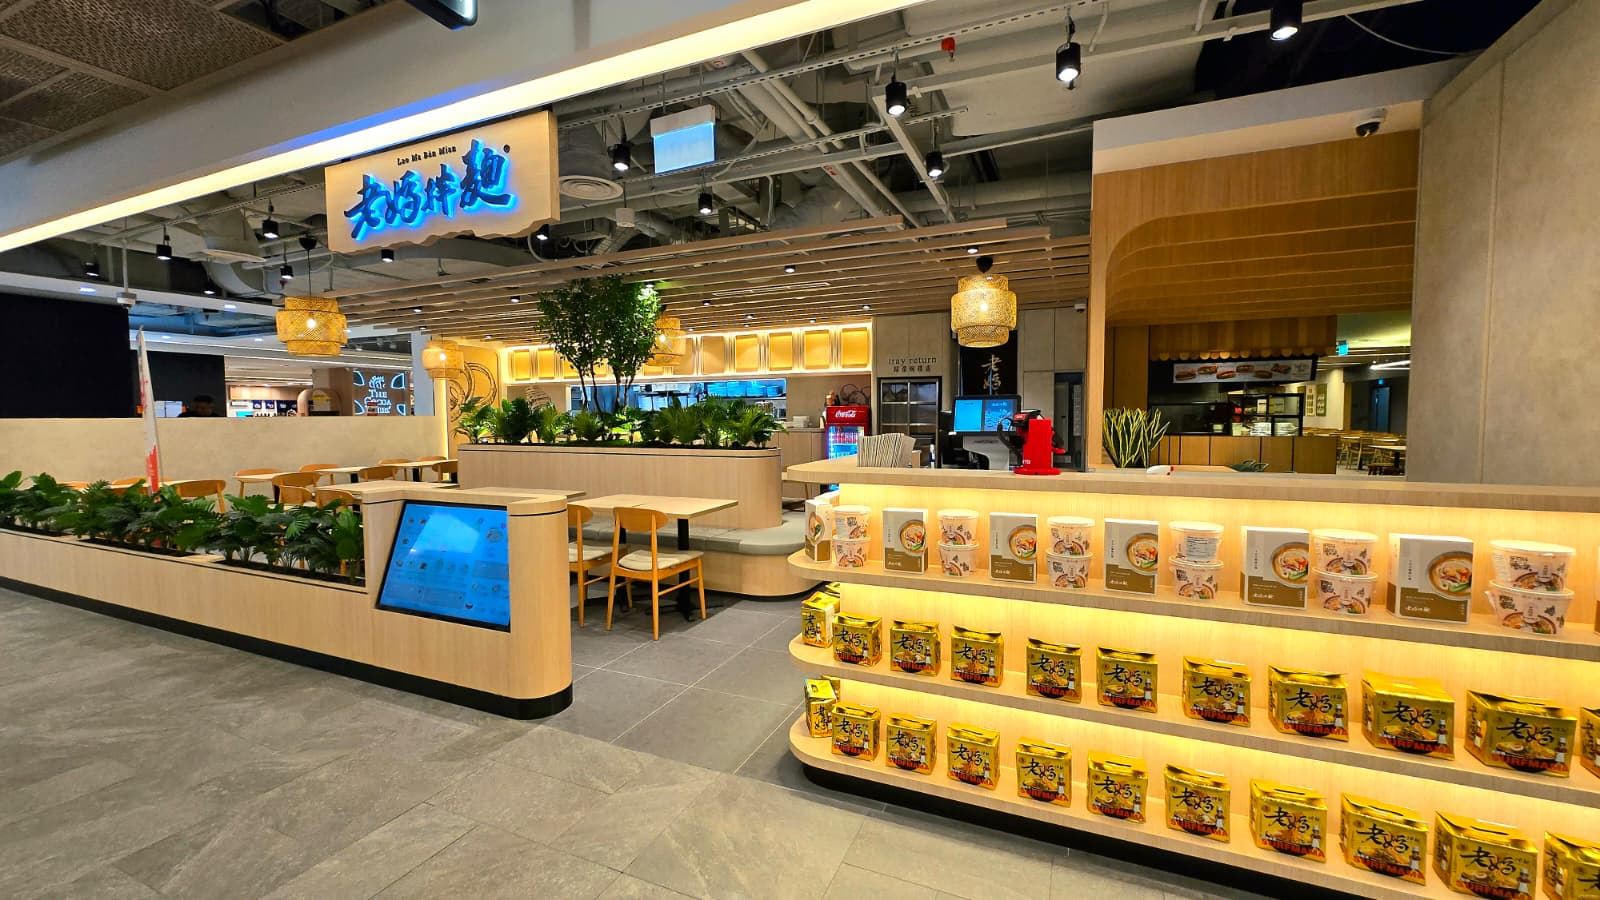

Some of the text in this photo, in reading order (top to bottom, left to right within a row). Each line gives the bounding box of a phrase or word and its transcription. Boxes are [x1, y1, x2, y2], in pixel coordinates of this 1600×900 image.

[397, 157, 409, 166] Lao
[411, 153, 422, 162] Ma
[438, 145, 457, 155] Mian
[888, 356, 937, 366] tray return
